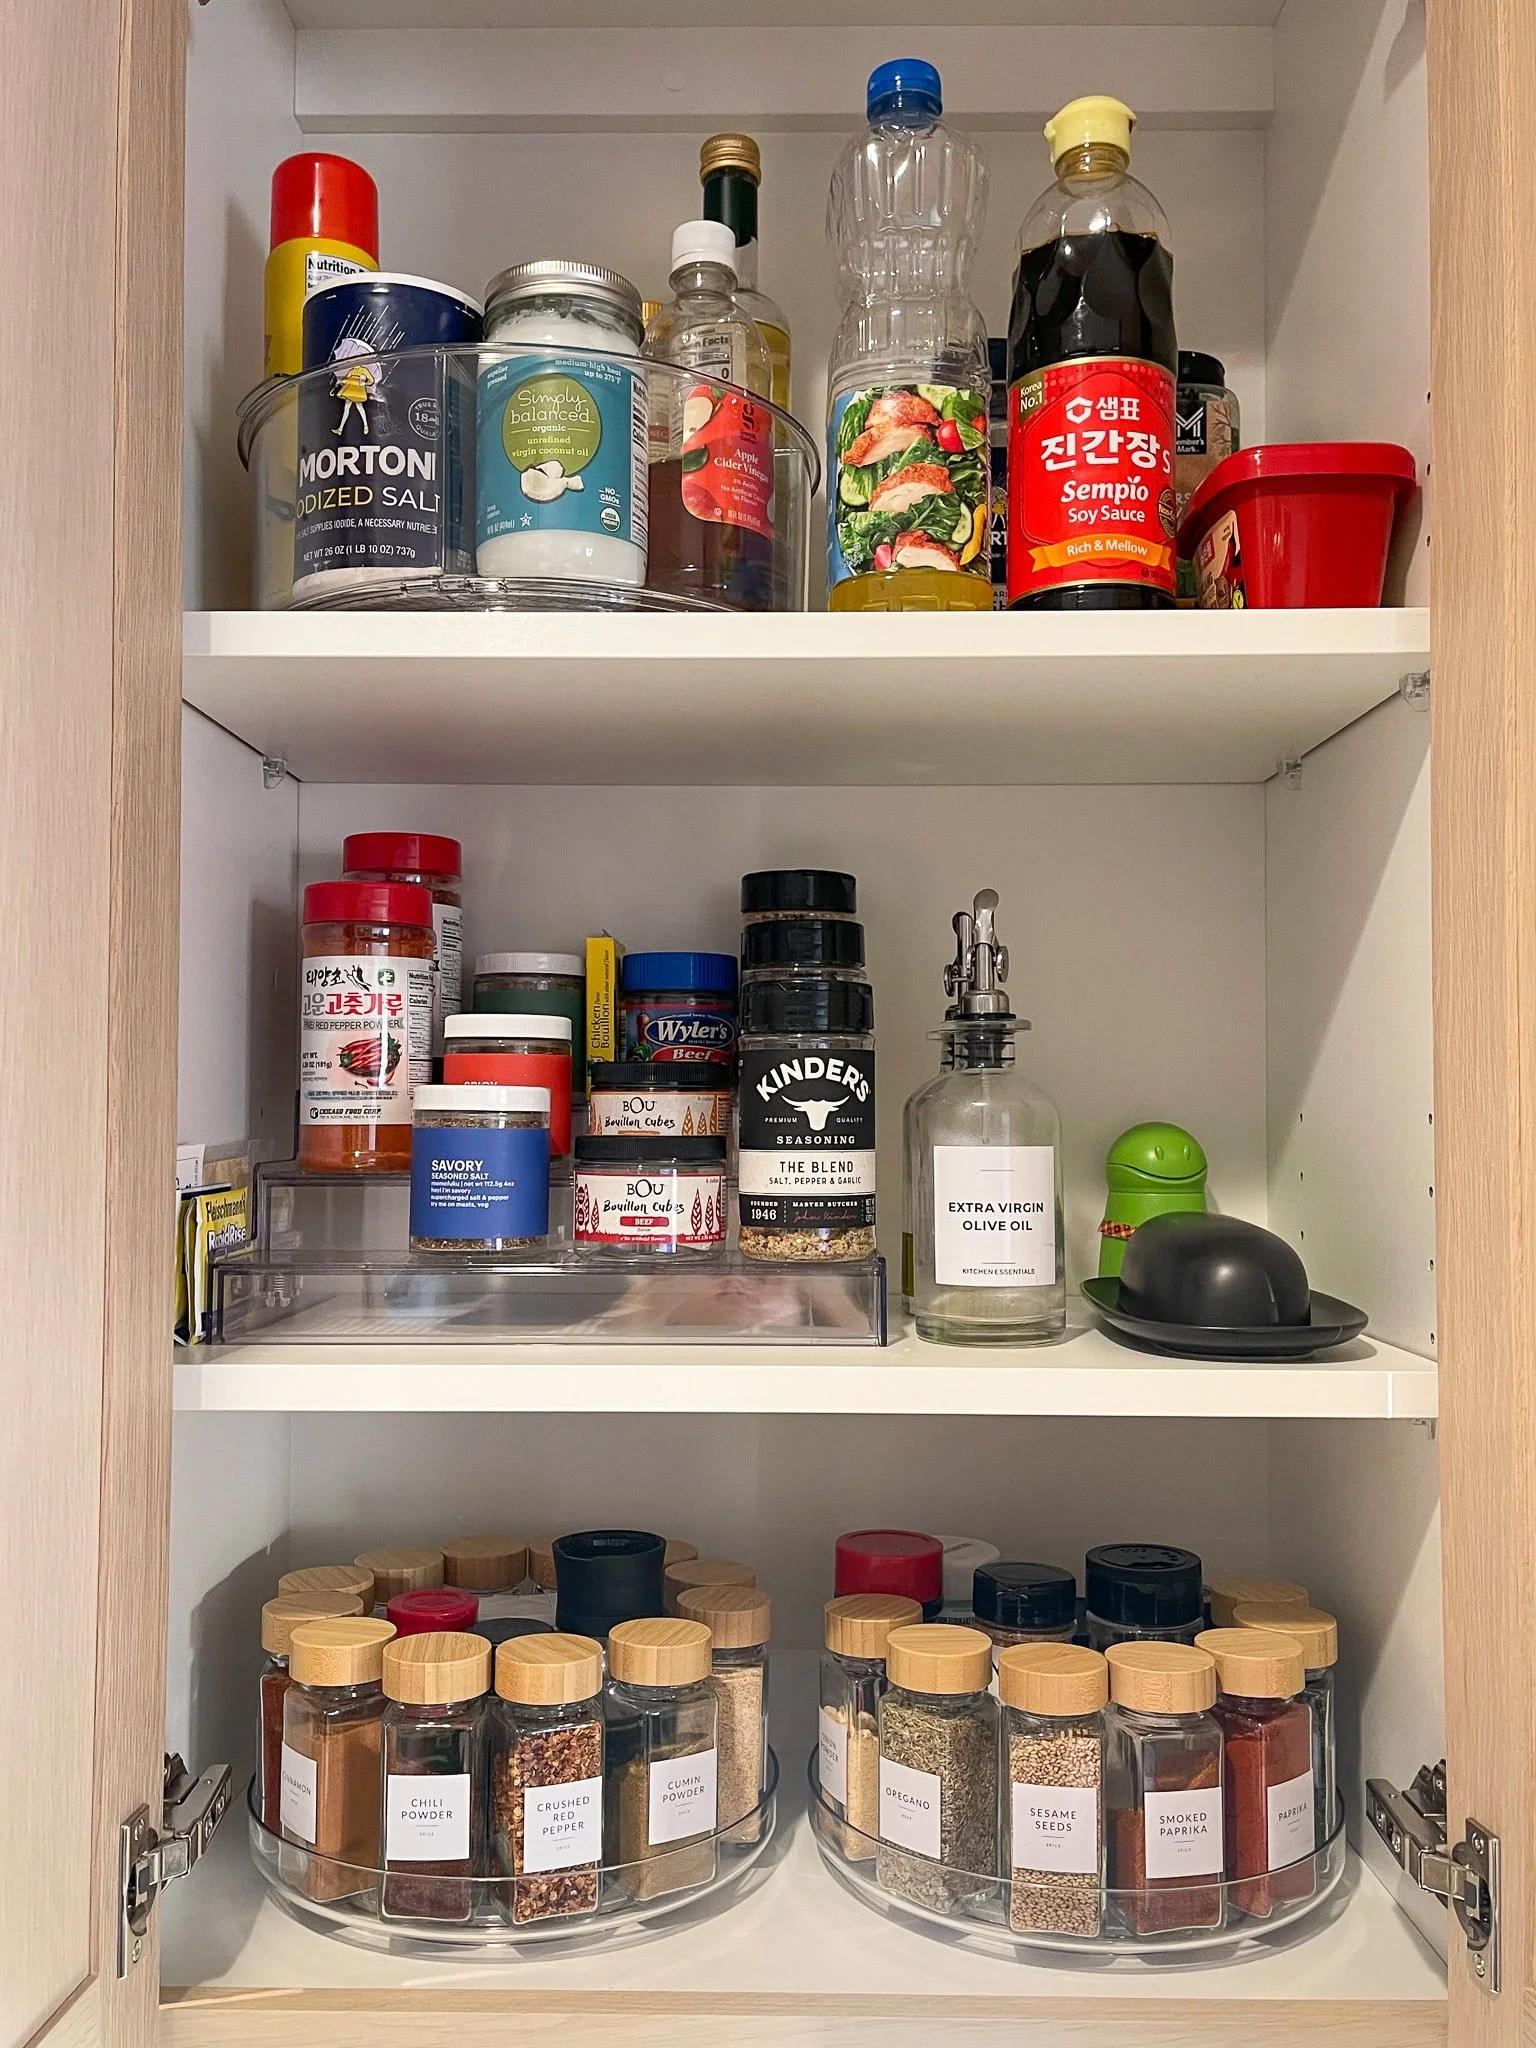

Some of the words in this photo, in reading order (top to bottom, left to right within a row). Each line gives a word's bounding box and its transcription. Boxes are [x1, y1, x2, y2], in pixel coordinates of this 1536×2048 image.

[555, 358, 605, 373] medium-high
[607, 365, 621, 377] heat
[584, 370, 597, 380] up
[721, 367, 730, 380] 0
[1020, 381, 1043, 398] Korea
[415, 401, 432, 411] TRUS
[518, 386, 587, 412] Simply
[1020, 392, 1044, 413] No.1
[511, 407, 589, 425] balanced
[1095, 396, 1140, 421] 샘표
[532, 424, 567, 434] organic
[527, 436, 571, 444] unrefined
[512, 449, 537, 458] virgin
[539, 446, 575, 456] coconut
[577, 447, 589, 457] oil
[735, 448, 759, 465] Apple
[1041, 429, 1161, 472] 진간장
[300, 445, 432, 488] MORTON
[714, 456, 742, 470] Cider
[605, 486, 616, 496] NO
[1061, 475, 1149, 505] Sempio
[297, 486, 374, 519] ODIZED
[382, 487, 440, 514] SALT
[600, 493, 620, 505] GMOs
[1068, 507, 1099, 525] Soy
[1101, 505, 1145, 523] Sauce
[334, 518, 357, 530] IODIDE,
[358, 519, 363, 527] A
[365, 518, 405, 529] NECESSARY
[314, 547, 324, 559] WT
[325, 547, 333, 556] 26
[335, 545, 345, 555] OZ
[346, 545, 353, 556] (1
[356, 544, 366, 554] LB
[369, 544, 378, 554] 10
[380, 544, 394, 556] OZ)
[396, 546, 416, 559] 737g
[1067, 540, 1092, 557] Rich
[1094, 539, 1104, 551] &
[1106, 540, 1148, 556] Mellow
[306, 966, 346, 987] 태양초
[316, 1021, 329, 1029] RED
[330, 1021, 362, 1030] PEPPER
[364, 1020, 401, 1029] POWER
[591, 1002, 601, 1049] Chicken
[601, 1003, 610, 1049] Bouillon
[655, 1020, 728, 1042] Wyler's
[672, 1048, 715, 1060] Beef
[756, 1057, 871, 1102] KINDER'S
[622, 1096, 656, 1114] BOU
[604, 1114, 641, 1129] Bouillon
[645, 1114, 676, 1129] Cubes
[776, 1135, 855, 1145] SEASONING
[431, 1160, 484, 1172] SAVORY
[779, 1161, 805, 1173] THE
[811, 1161, 854, 1173] BLEND
[794, 1177, 826, 1185] PEPPER
[830, 1177, 835, 1185] &
[838, 1176, 862, 1185] GARLIC
[626, 1179, 664, 1198] BOU
[603, 1199, 648, 1214] Bouillon
[948, 1202, 995, 1213] EXTRA
[998, 1202, 1044, 1213] VIRGIN
[635, 1218, 654, 1226] BEEF
[751, 1209, 777, 1220] 1946
[963, 1220, 1006, 1231] OLIVE
[1010, 1220, 1033, 1231] OIL
[282, 1770, 311, 1796] CINNAMON
[667, 1775, 702, 1791] CUMIN
[662, 1785, 705, 1803] POWDER
[885, 1787, 930, 1810] OREGANO
[411, 1799, 443, 1808] CHILI
[537, 1796, 590, 1812] CRUSHED
[401, 1810, 453, 1820] POWDER
[553, 1811, 575, 1822] RED
[1030, 1807, 1077, 1820] SESAME
[1159, 1812, 1207, 1824] SMOKED
[1278, 1802, 1308, 1821] PAPRIKA
[542, 1821, 585, 1836] PEPPER
[1035, 1820, 1073, 1832] SEEDS
[1160, 1824, 1208, 1836] PAPRIKA
